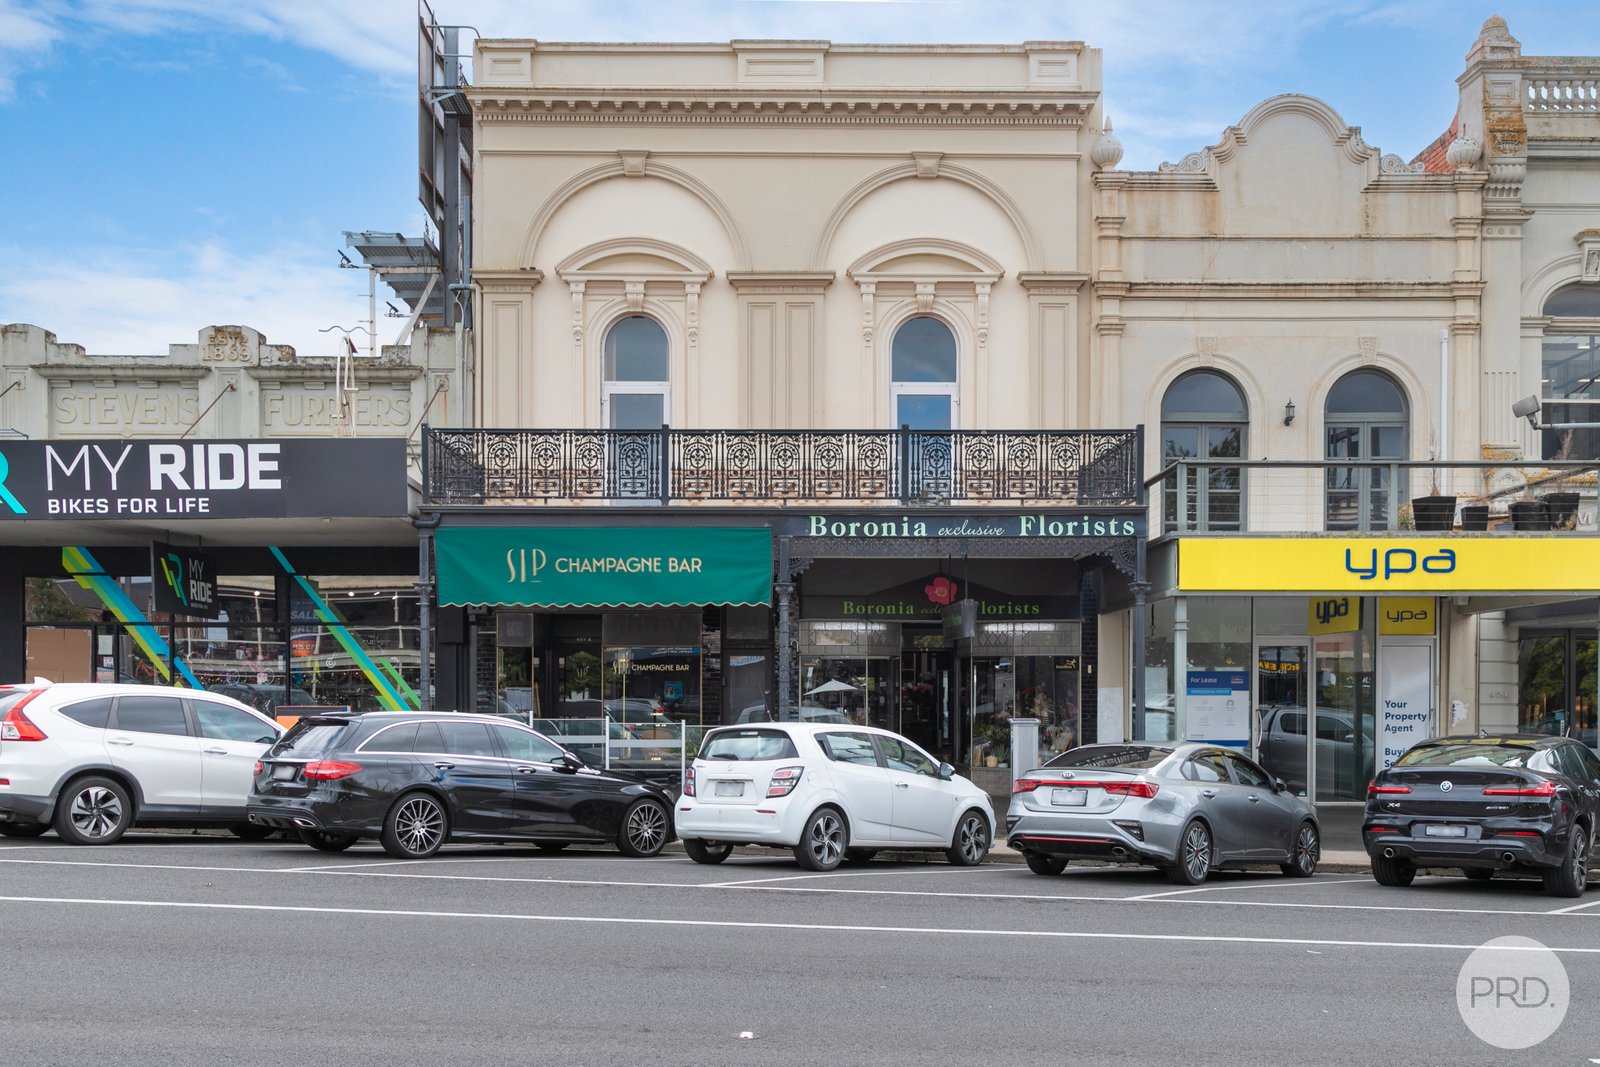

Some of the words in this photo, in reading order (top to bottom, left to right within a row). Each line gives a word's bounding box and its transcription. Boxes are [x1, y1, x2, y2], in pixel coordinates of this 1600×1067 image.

[56, 392, 200, 425] STEVENS
[264, 394, 411, 427] FURRERS
[45, 444, 133, 491] MY
[148, 443, 282, 491] RIDE
[48, 498, 109, 514] BIKES
[117, 498, 158, 514] FOR
[166, 497, 210, 513] LIFE
[808, 515, 928, 537] Boronia
[938, 519, 1006, 536] exclusive
[1018, 514, 1136, 537] Florists
[189, 558, 204, 580] MY
[506, 548, 547, 583] SIP
[554, 556, 662, 573] CHAMPAGNE
[668, 556, 702, 573] BAR
[1345, 548, 1456, 580] ypa
[190, 580, 213, 604] RIDE
[843, 601, 915, 615] Boronia
[980, 600, 1040, 615] lorists
[1316, 597, 1349, 624] ypa
[1386, 610, 1428, 622] ypa
[1385, 700, 1407, 708] Your
[1385, 712, 1427, 722] Property
[1384, 724, 1414, 734] Agent
[1384, 748, 1407, 757] Buyi
